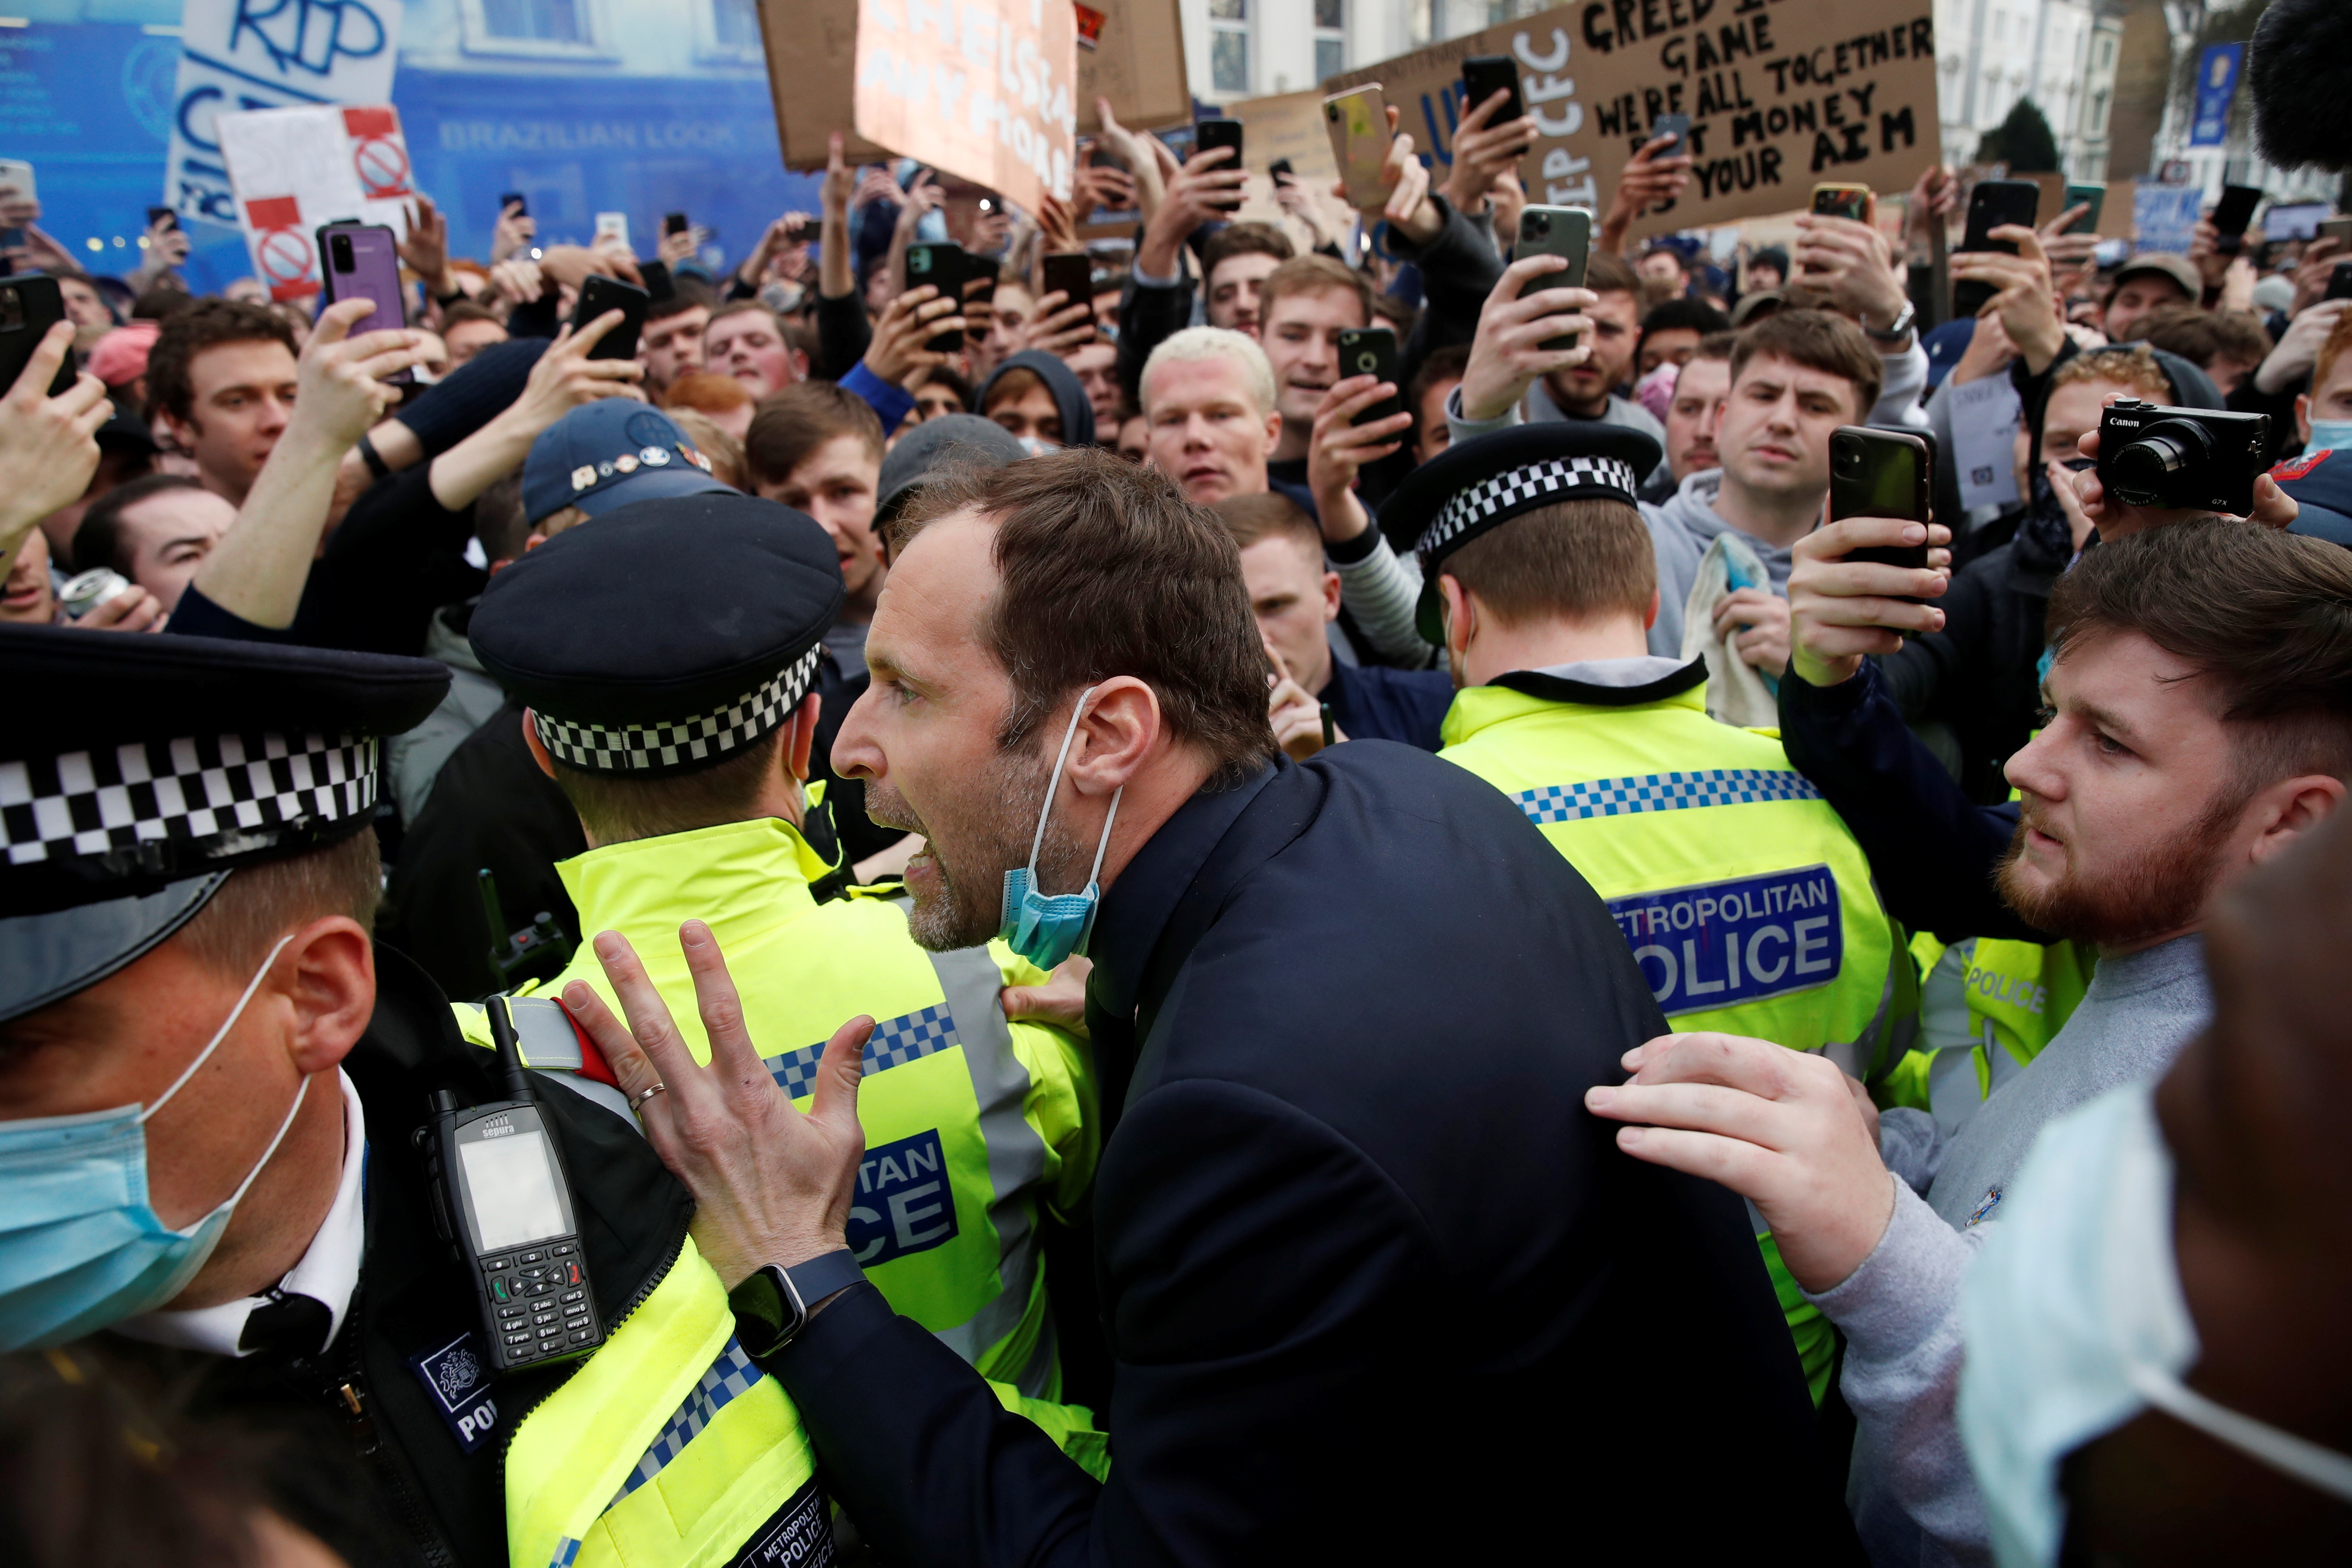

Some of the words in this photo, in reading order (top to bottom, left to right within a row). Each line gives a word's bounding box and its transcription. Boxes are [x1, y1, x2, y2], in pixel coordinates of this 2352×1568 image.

[1583, 0, 1715, 54] GREED
[1661, 14, 1774, 77] GAME
[1512, 27, 1584, 138] CFC
[1697, 70, 1754, 119] ALL
[1765, 15, 1934, 94] TOGETHER
[1732, 82, 1877, 147] MONEY
[1692, 147, 1782, 200] YOUR
[1811, 106, 1916, 172] AIM
[2110, 417, 2140, 428] Canon
[2111, 449, 2125, 464] CANON
[1966, 967, 2049, 1015] POLICE
[482, 1124, 515, 1137] sepura
[780, 1513, 823, 1568] POLICE
